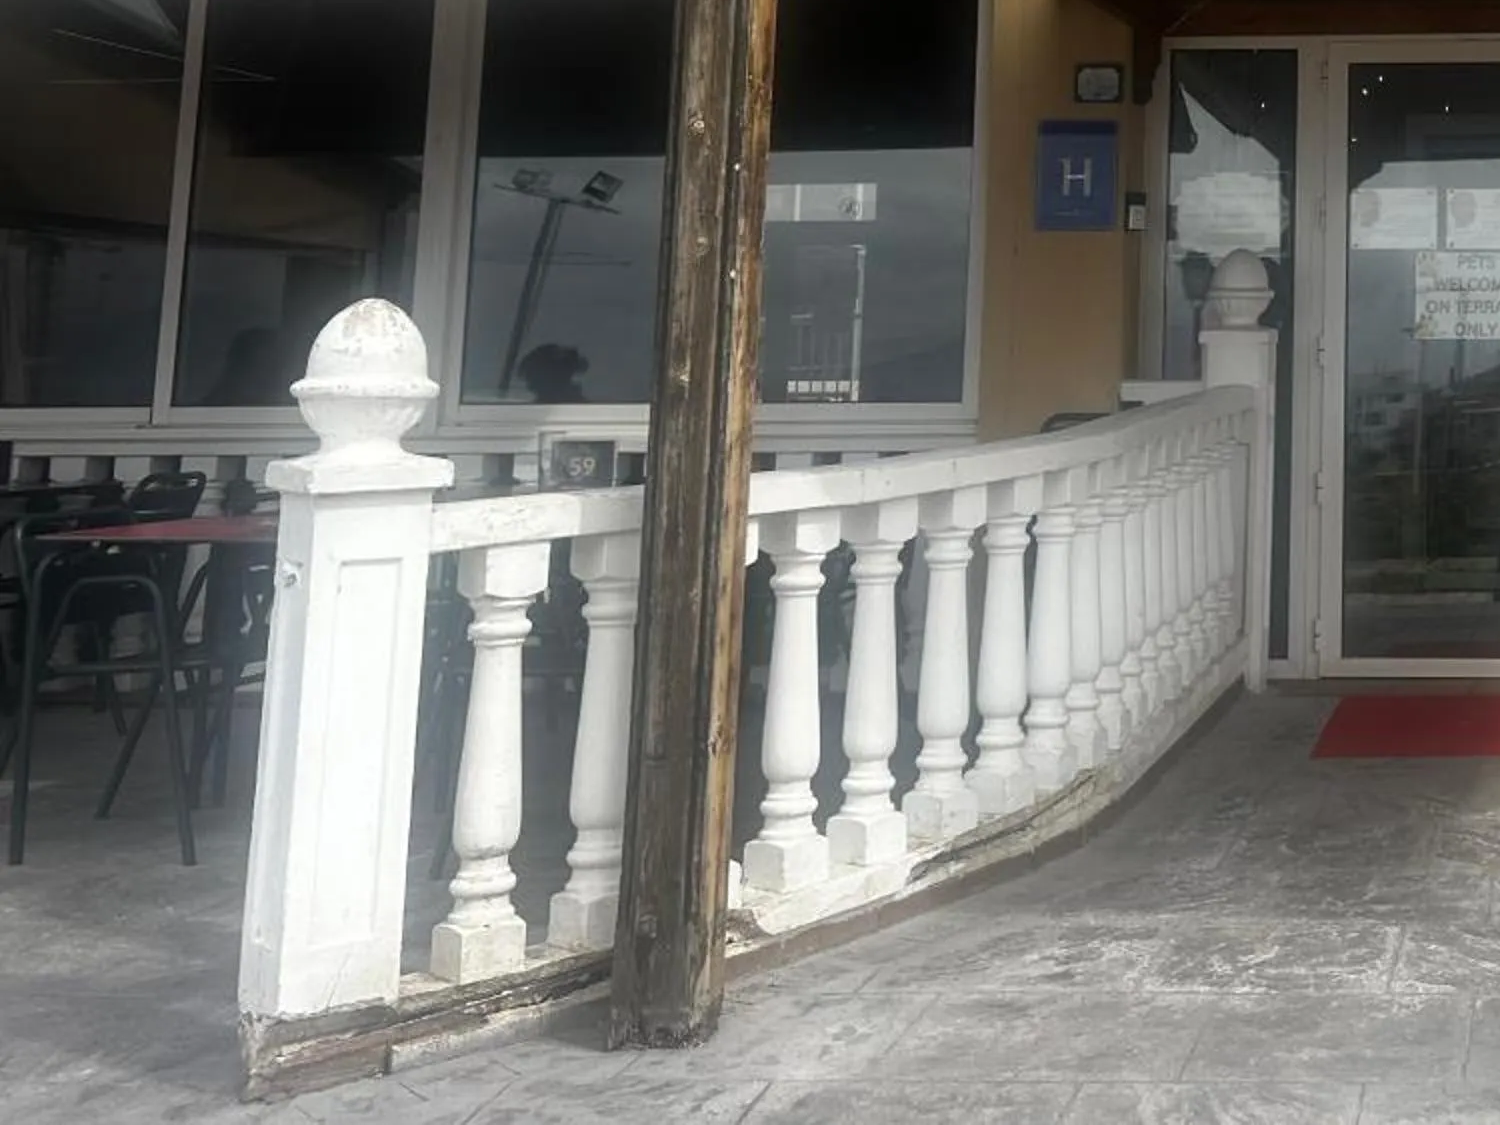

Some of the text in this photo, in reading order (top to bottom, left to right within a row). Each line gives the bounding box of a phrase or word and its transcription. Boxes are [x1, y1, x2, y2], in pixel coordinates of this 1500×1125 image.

[1457, 254, 1497, 271] PETS
[1425, 300, 1451, 315] ON
[1455, 322, 1499, 338] ONLY
[568, 457, 597, 477] 59
